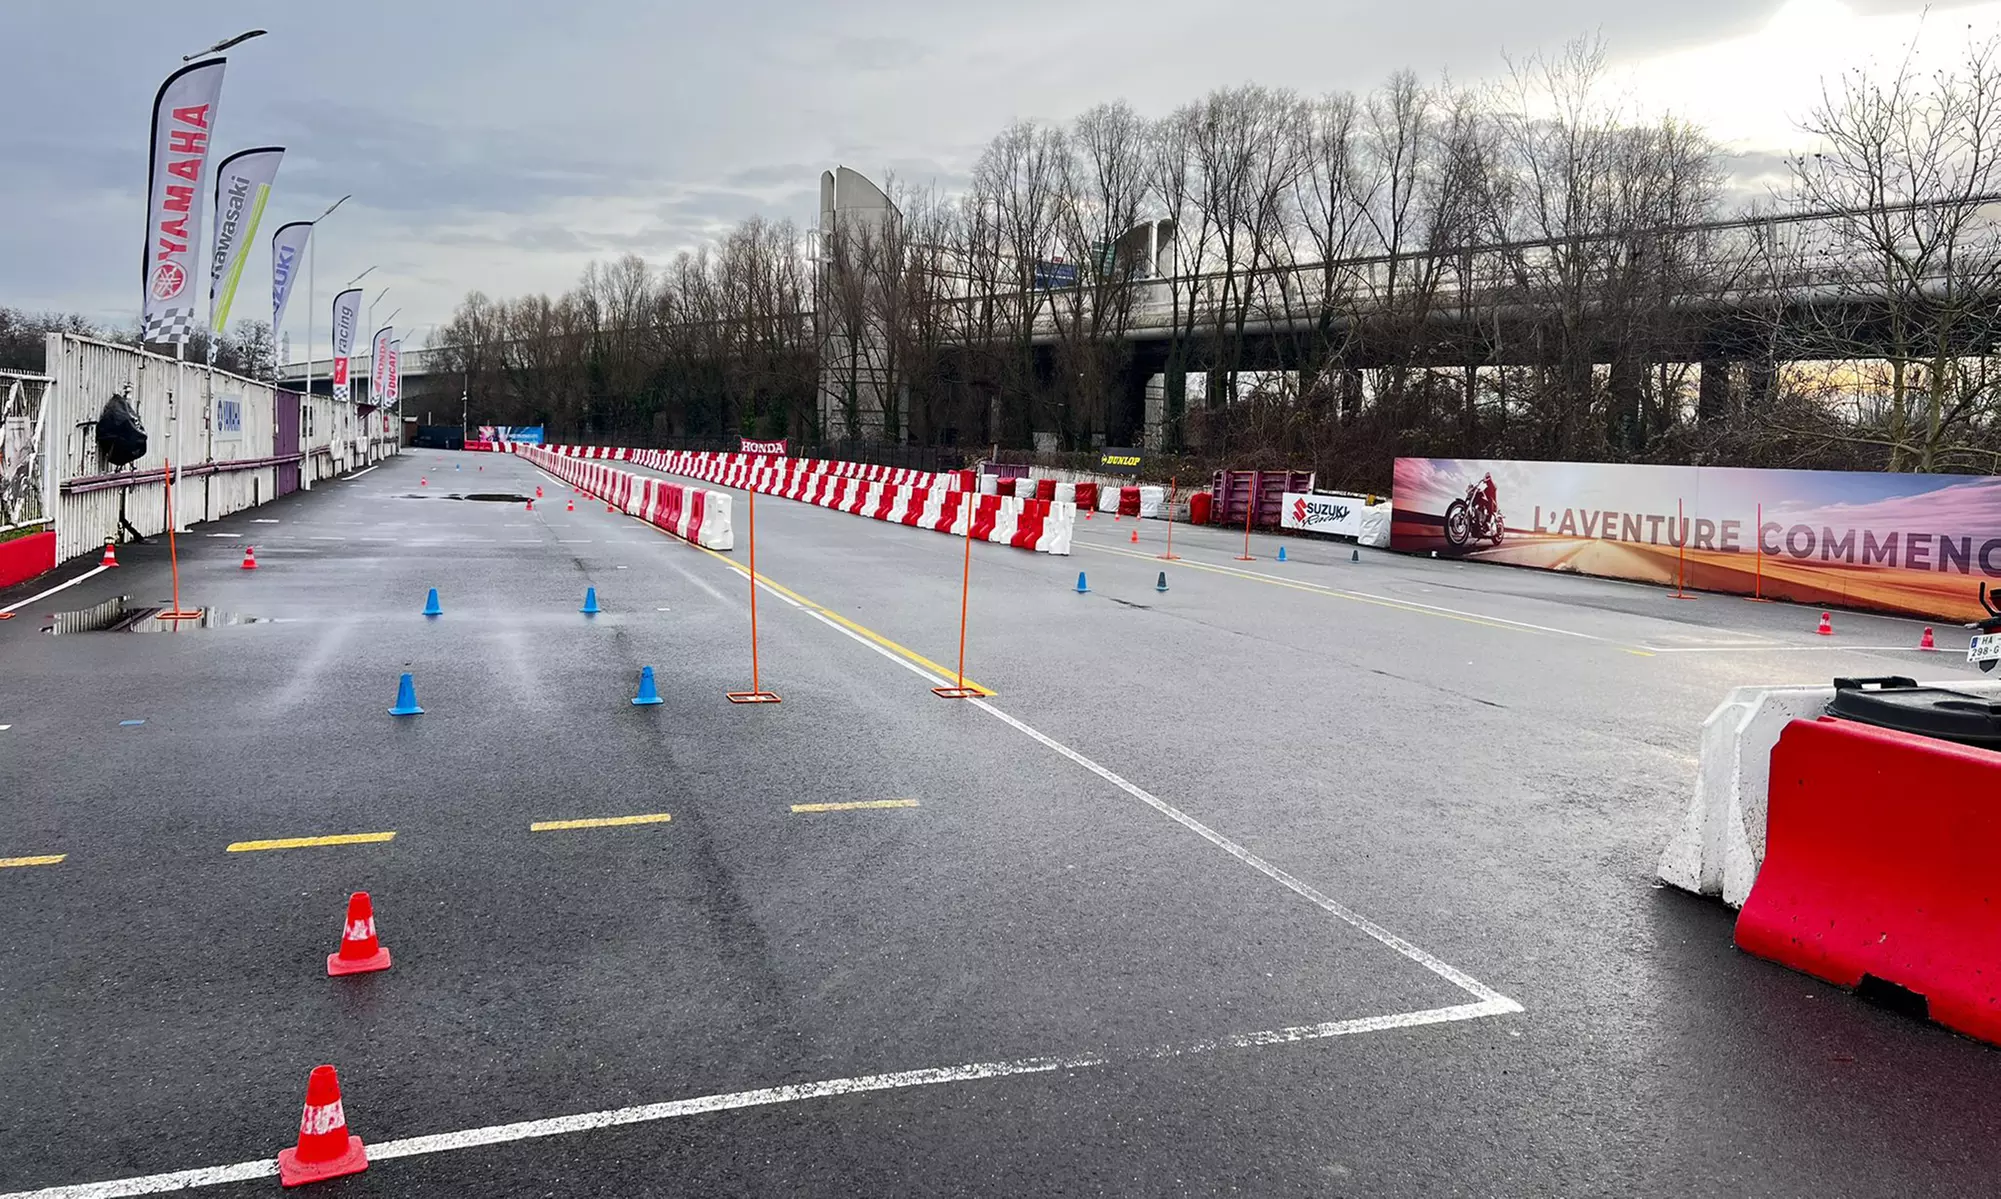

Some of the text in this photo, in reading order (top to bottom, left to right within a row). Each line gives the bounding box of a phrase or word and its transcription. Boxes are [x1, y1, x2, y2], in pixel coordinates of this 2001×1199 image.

[158, 103, 209, 260] YAMAHA
[338, 305, 353, 354] racing
[377, 338, 386, 380] HONDA
[742, 441, 785, 453] HONDA
[1107, 455, 1141, 466] DUNLOP
[1306, 502, 1349, 518] SUZUKI
[1533, 505, 2001, 578] L'AVENTURE COMMENC
